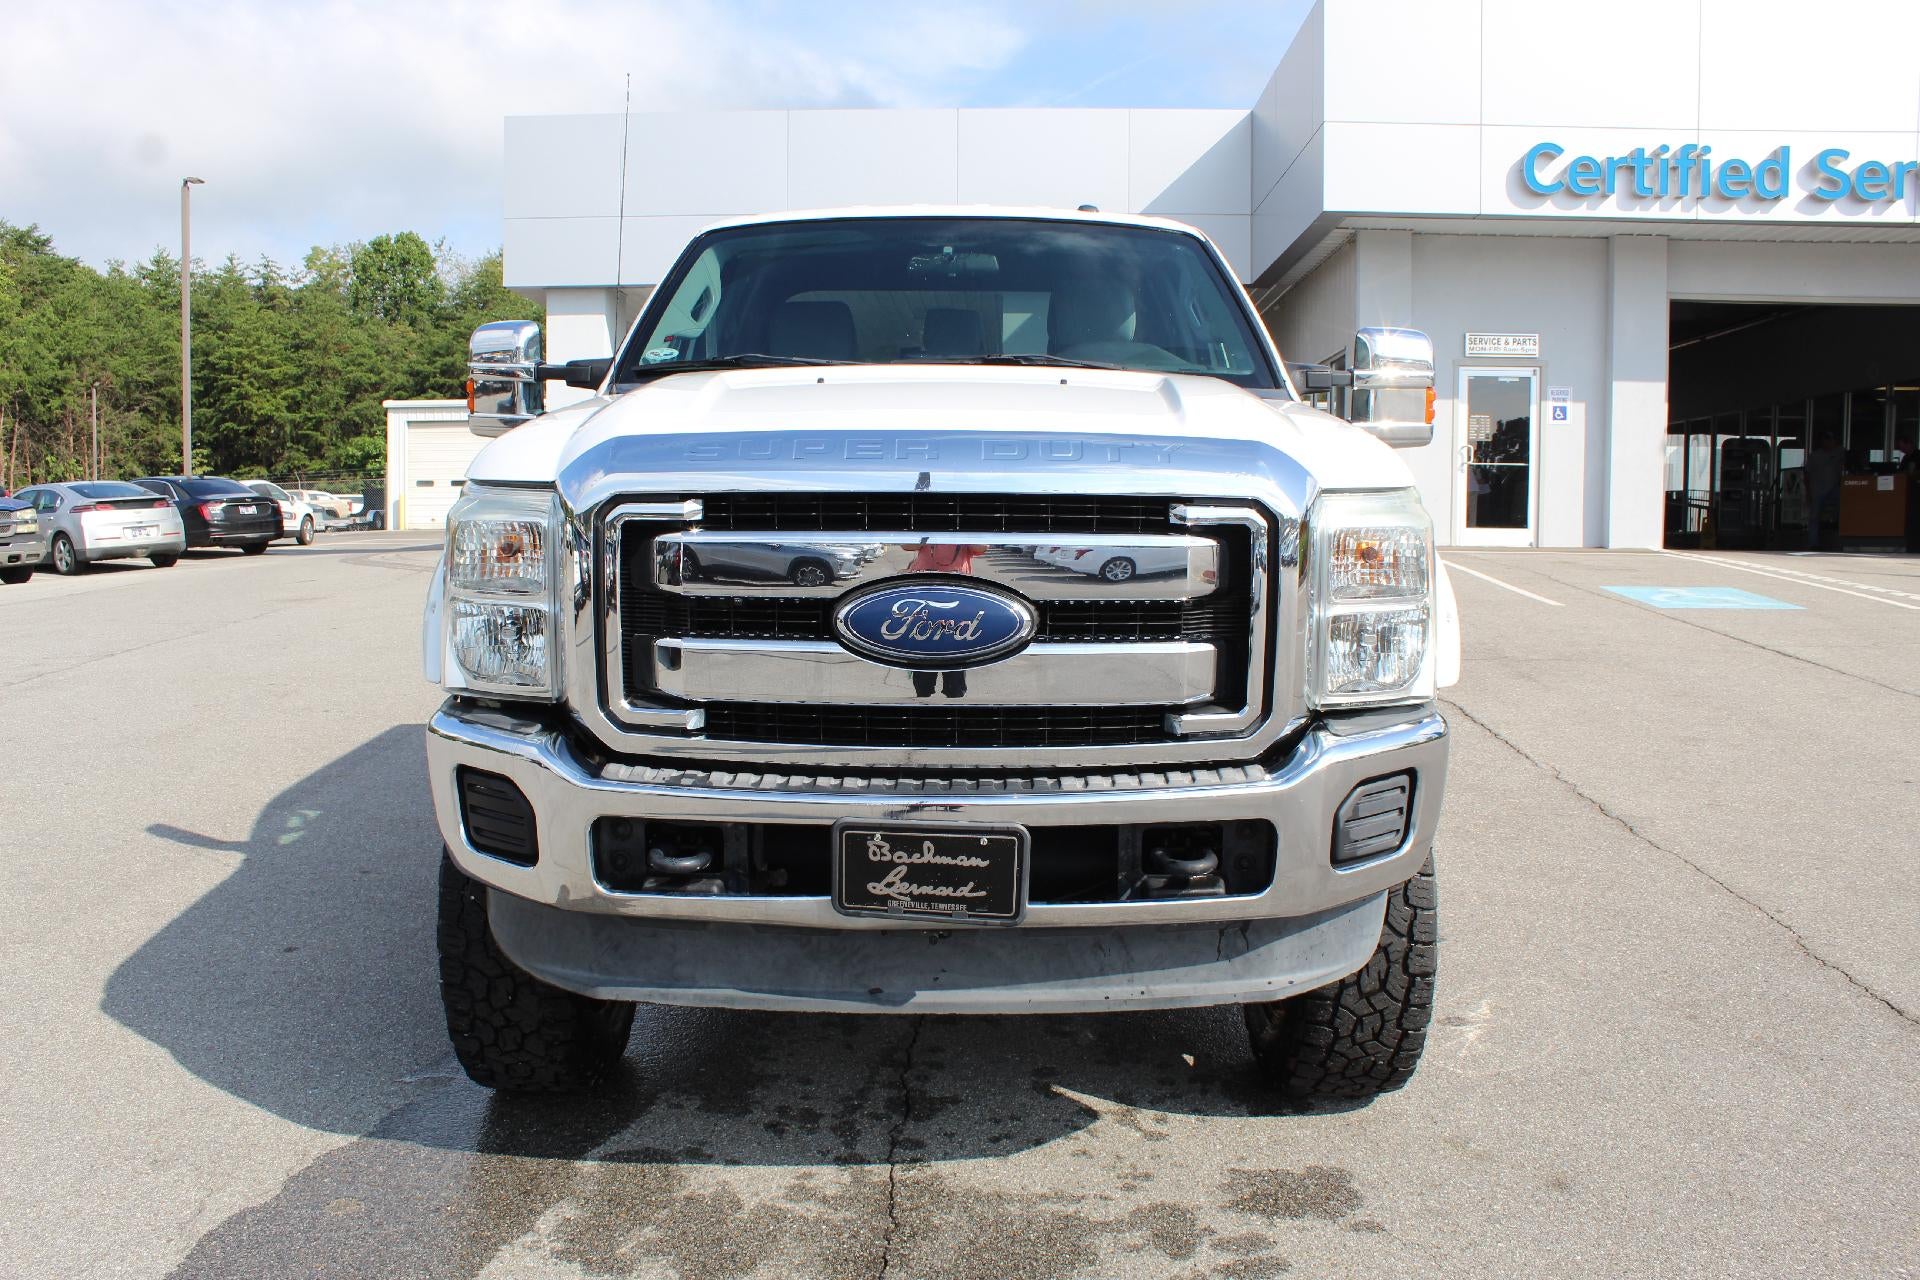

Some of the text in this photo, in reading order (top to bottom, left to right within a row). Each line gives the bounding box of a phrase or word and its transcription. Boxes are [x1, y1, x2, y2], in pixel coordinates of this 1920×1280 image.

[1522, 142, 1791, 200] Certified
[1468, 337, 1537, 346] SERVICE & PARTS
[684, 438, 1185, 464] SUPER DUTY
[880, 598, 985, 641] Ford
[866, 840, 990, 868] Bachman
